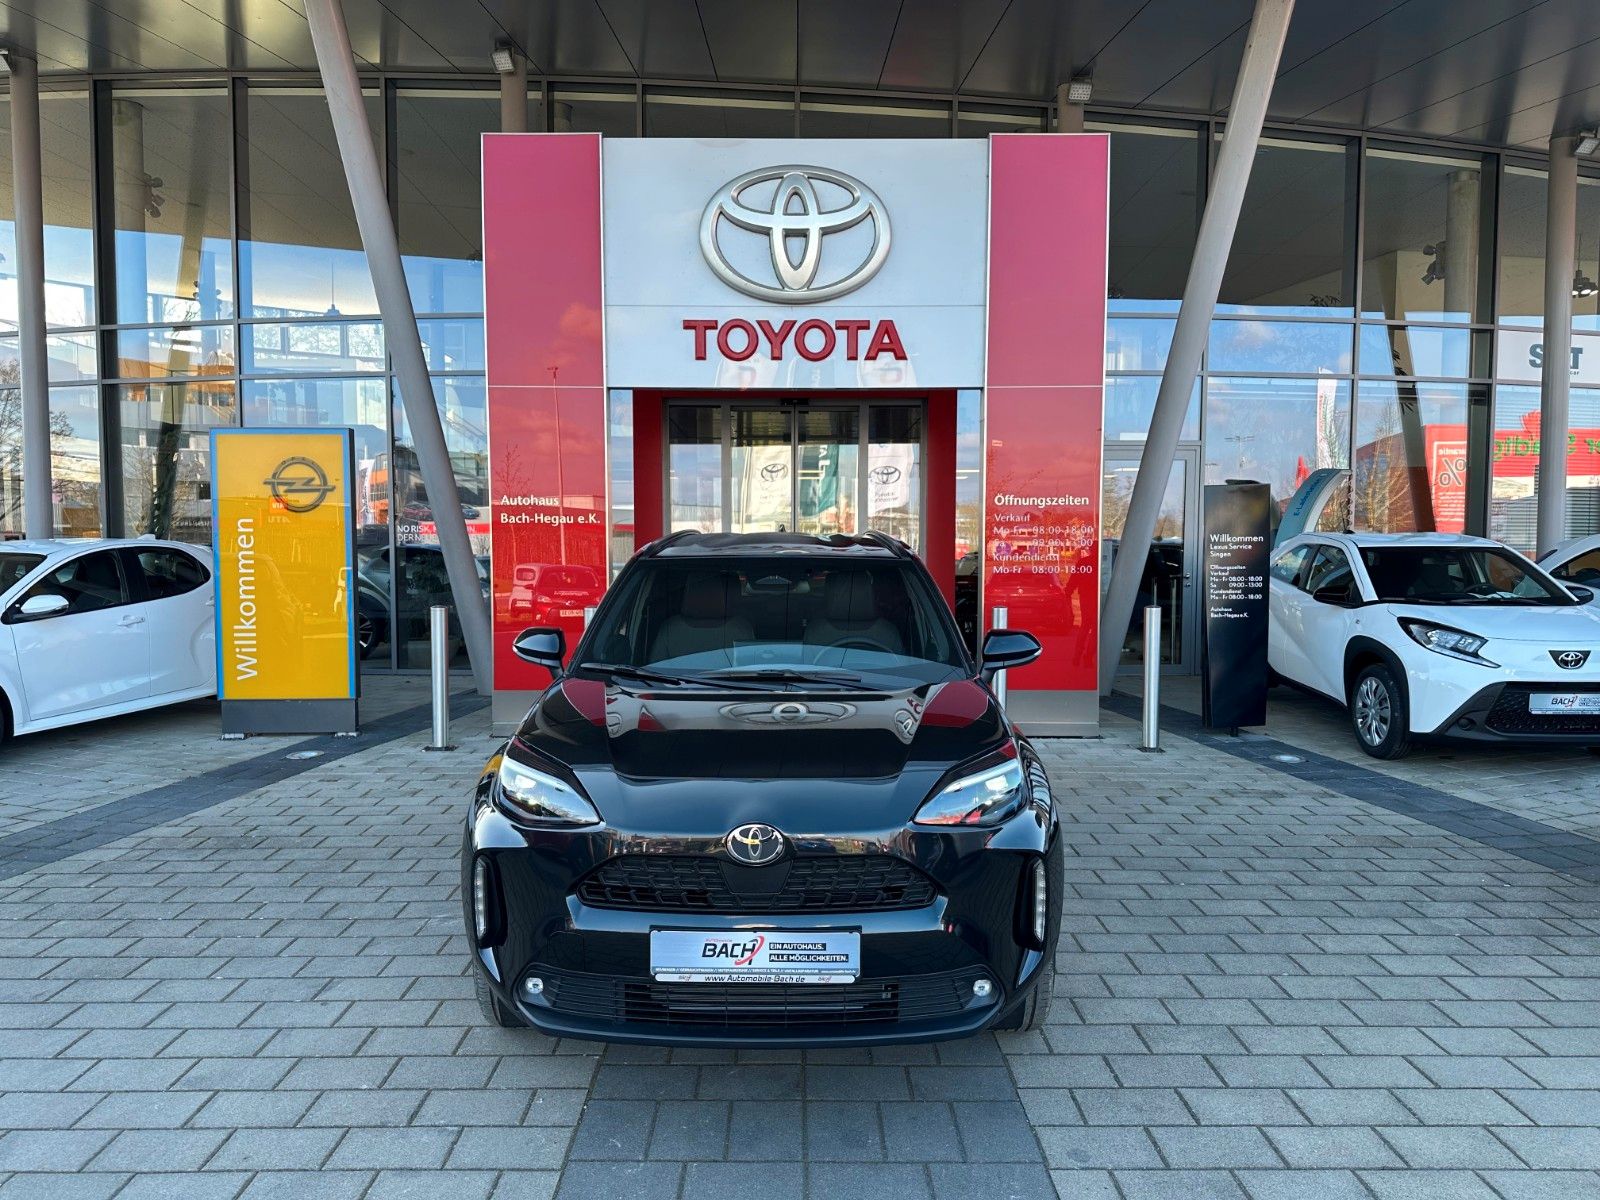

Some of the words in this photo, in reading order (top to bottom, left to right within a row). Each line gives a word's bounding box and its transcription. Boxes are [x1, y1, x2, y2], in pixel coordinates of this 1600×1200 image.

[682, 318, 908, 362] TOYOTA
[500, 495, 559, 506] Autohaus
[994, 493, 1089, 508] Öffnungszeiten
[500, 513, 574, 526] Bach-Hegau
[578, 513, 600, 524] e.K.
[994, 514, 1030, 522] Verkauf
[1210, 534, 1264, 542] Willkommen
[994, 552, 1060, 561] Kundendienst
[994, 566, 1022, 574] Mo-Fr
[1032, 566, 1092, 574] 08:00-18:00
[233, 517, 258, 681] Willkommen
[702, 939, 760, 962] BACH
